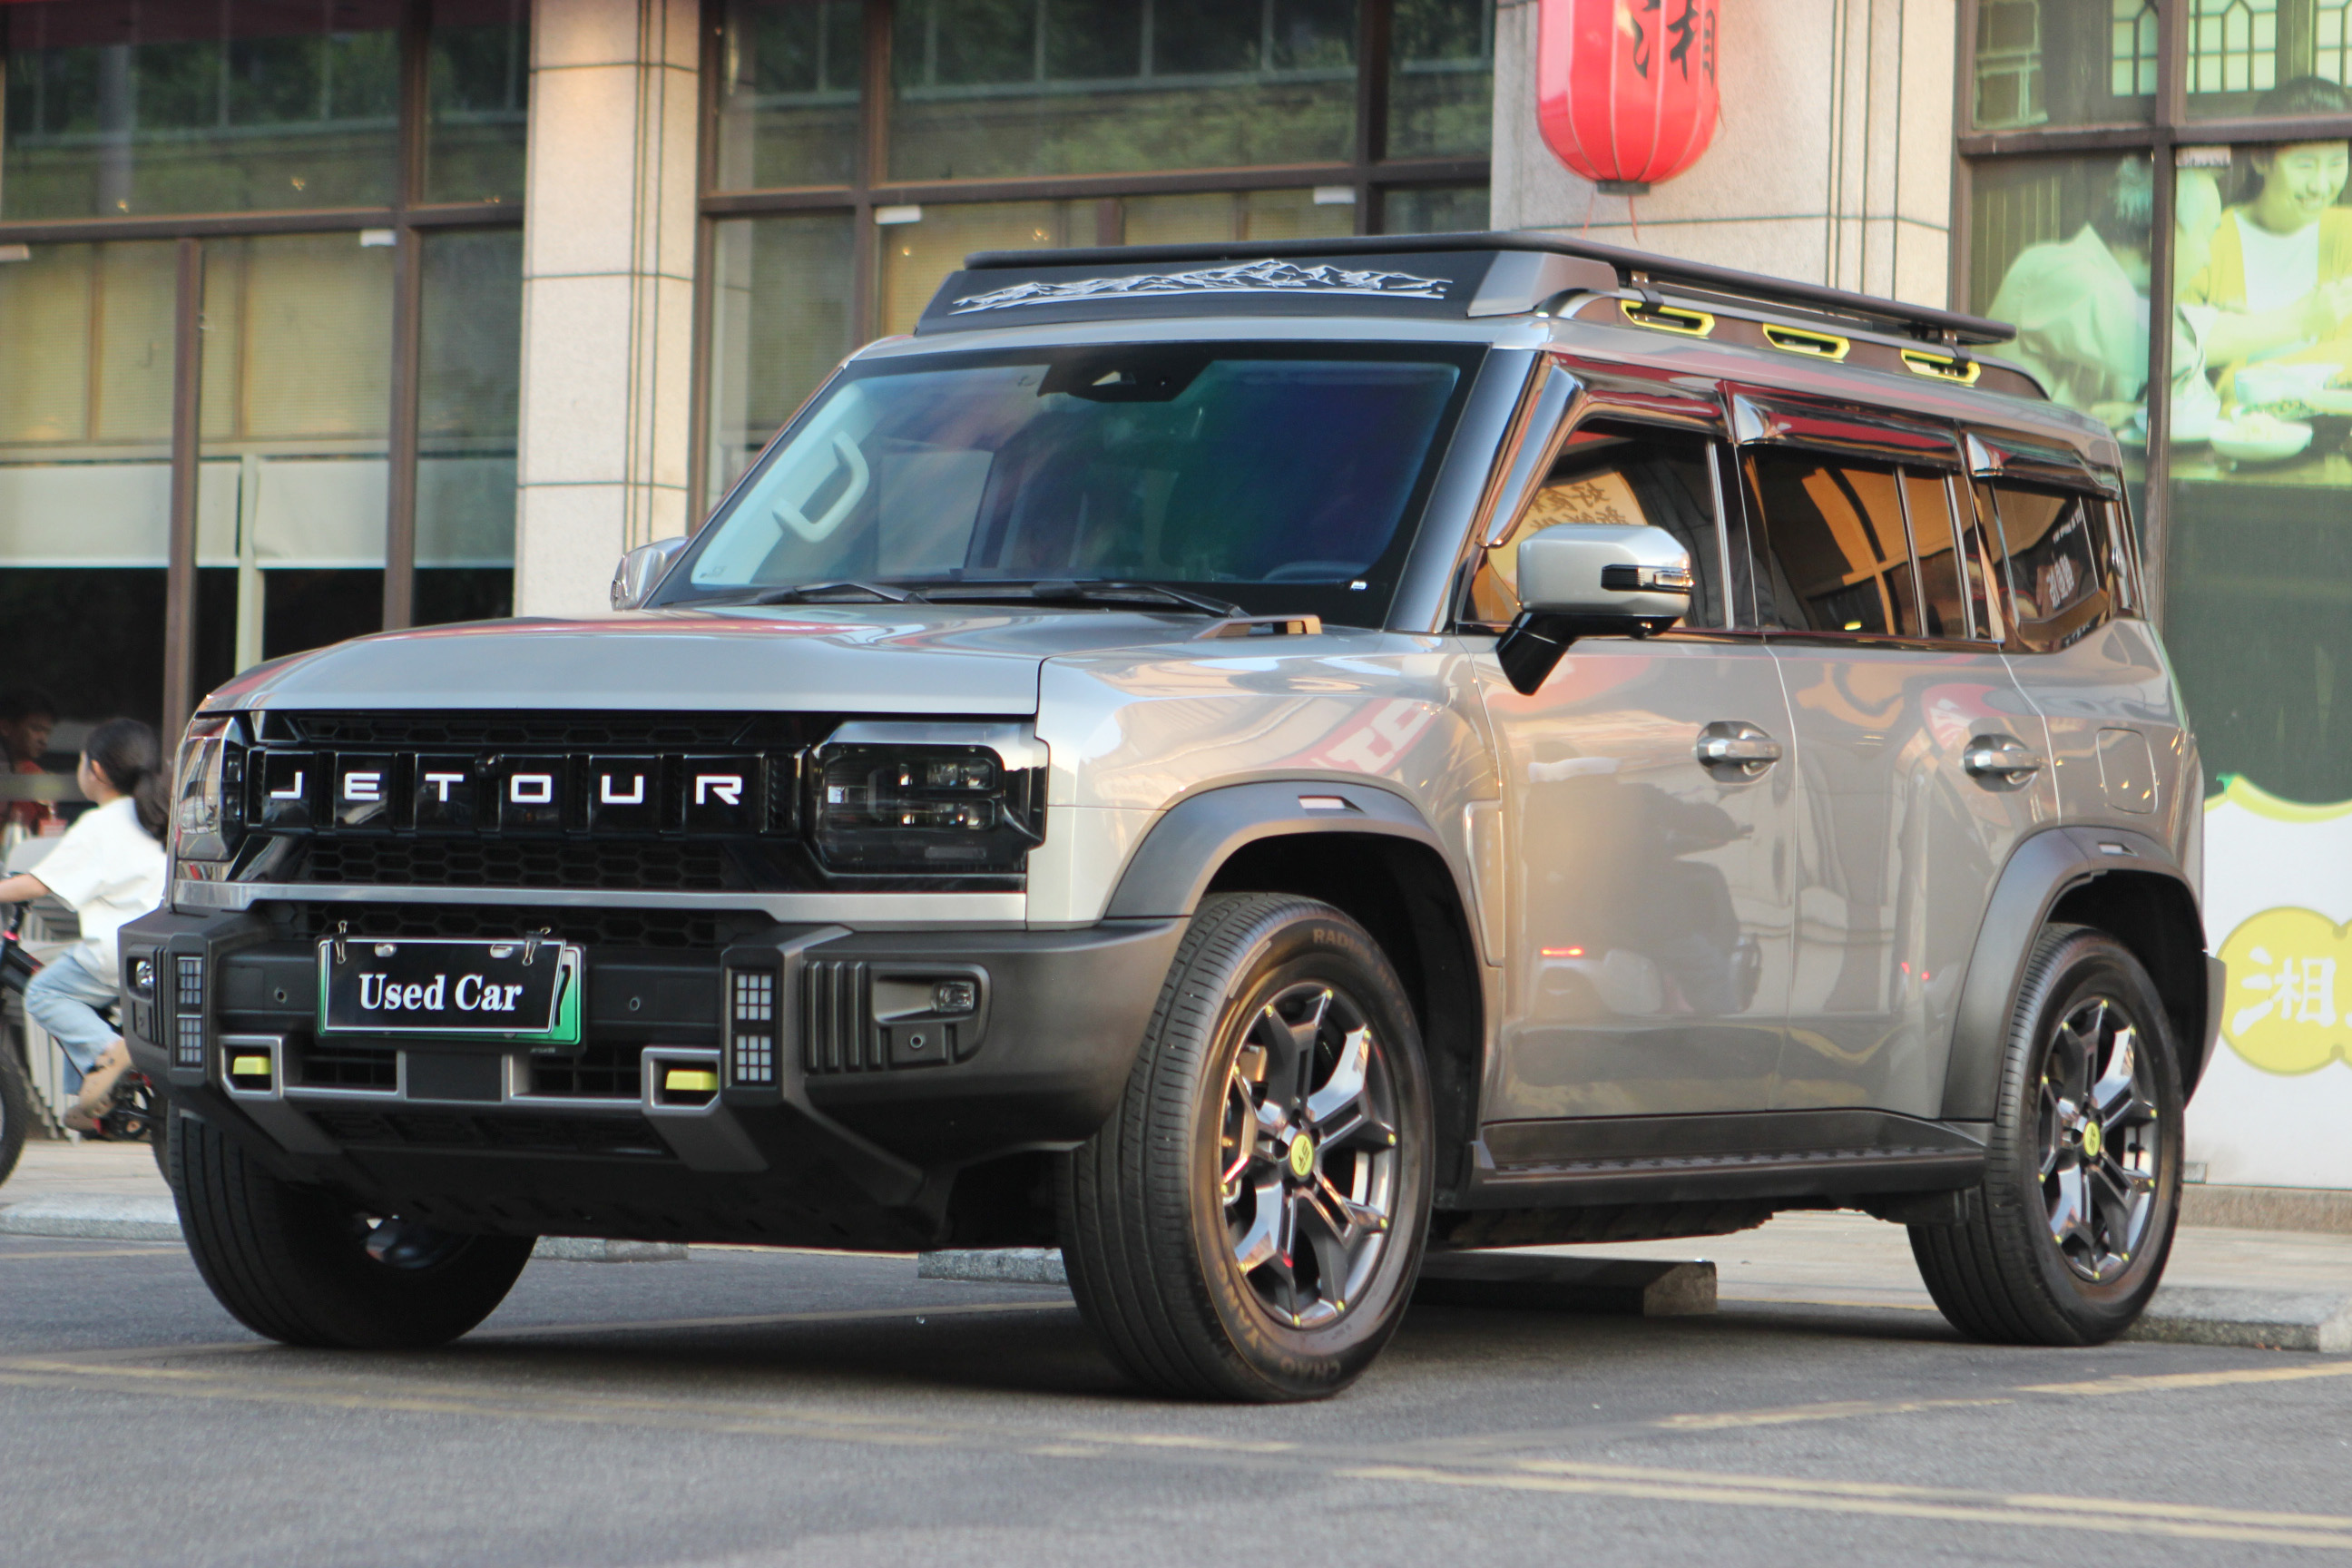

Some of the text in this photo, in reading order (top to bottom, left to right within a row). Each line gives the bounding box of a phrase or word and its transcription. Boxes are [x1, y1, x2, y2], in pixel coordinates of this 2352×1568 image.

[270, 771, 742, 805] JETOUR
[359, 974, 523, 1011] Used Car
[2231, 946, 2352, 1036] 湘
